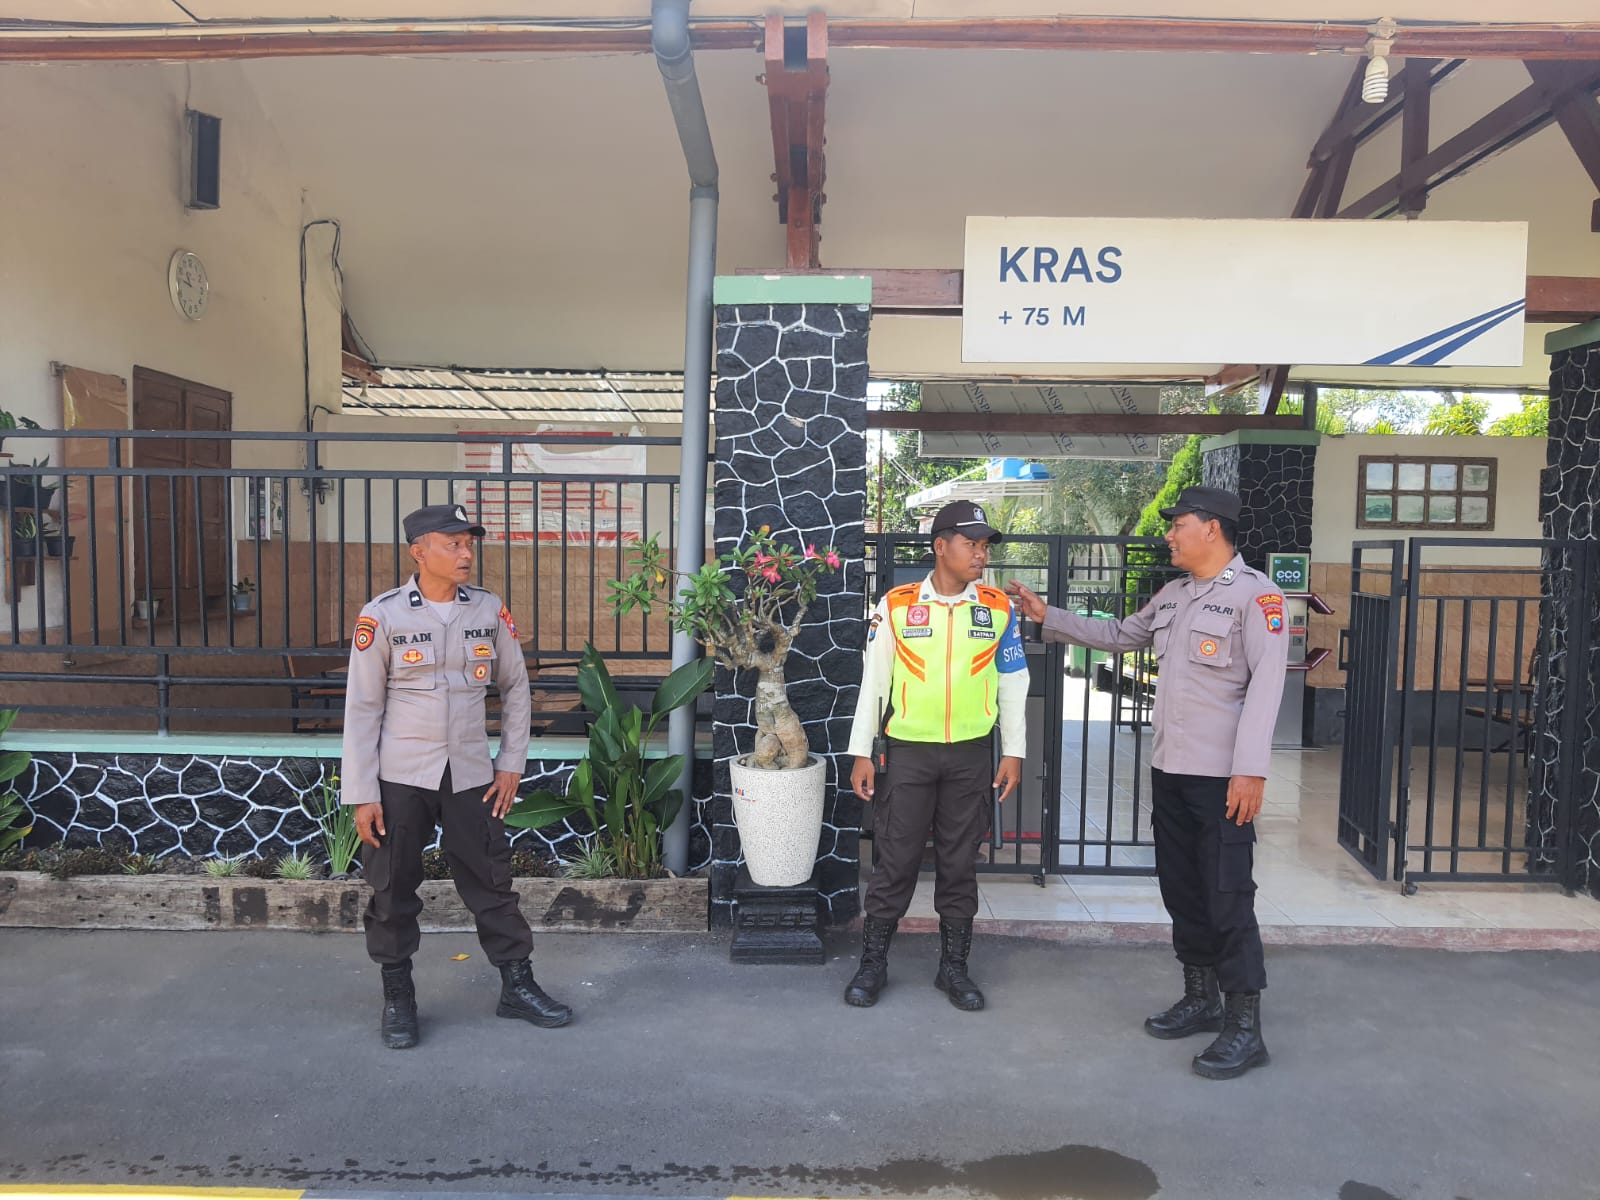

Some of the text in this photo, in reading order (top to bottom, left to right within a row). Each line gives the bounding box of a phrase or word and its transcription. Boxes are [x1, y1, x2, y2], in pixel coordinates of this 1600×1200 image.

[999, 246, 1123, 284] KRAS
[998, 305, 1086, 326] + 75 M
[1276, 570, 1301, 579] eco
[1202, 603, 1234, 616] POLRI
[410, 632, 433, 644] ADI
[464, 627, 496, 640] POLRI
